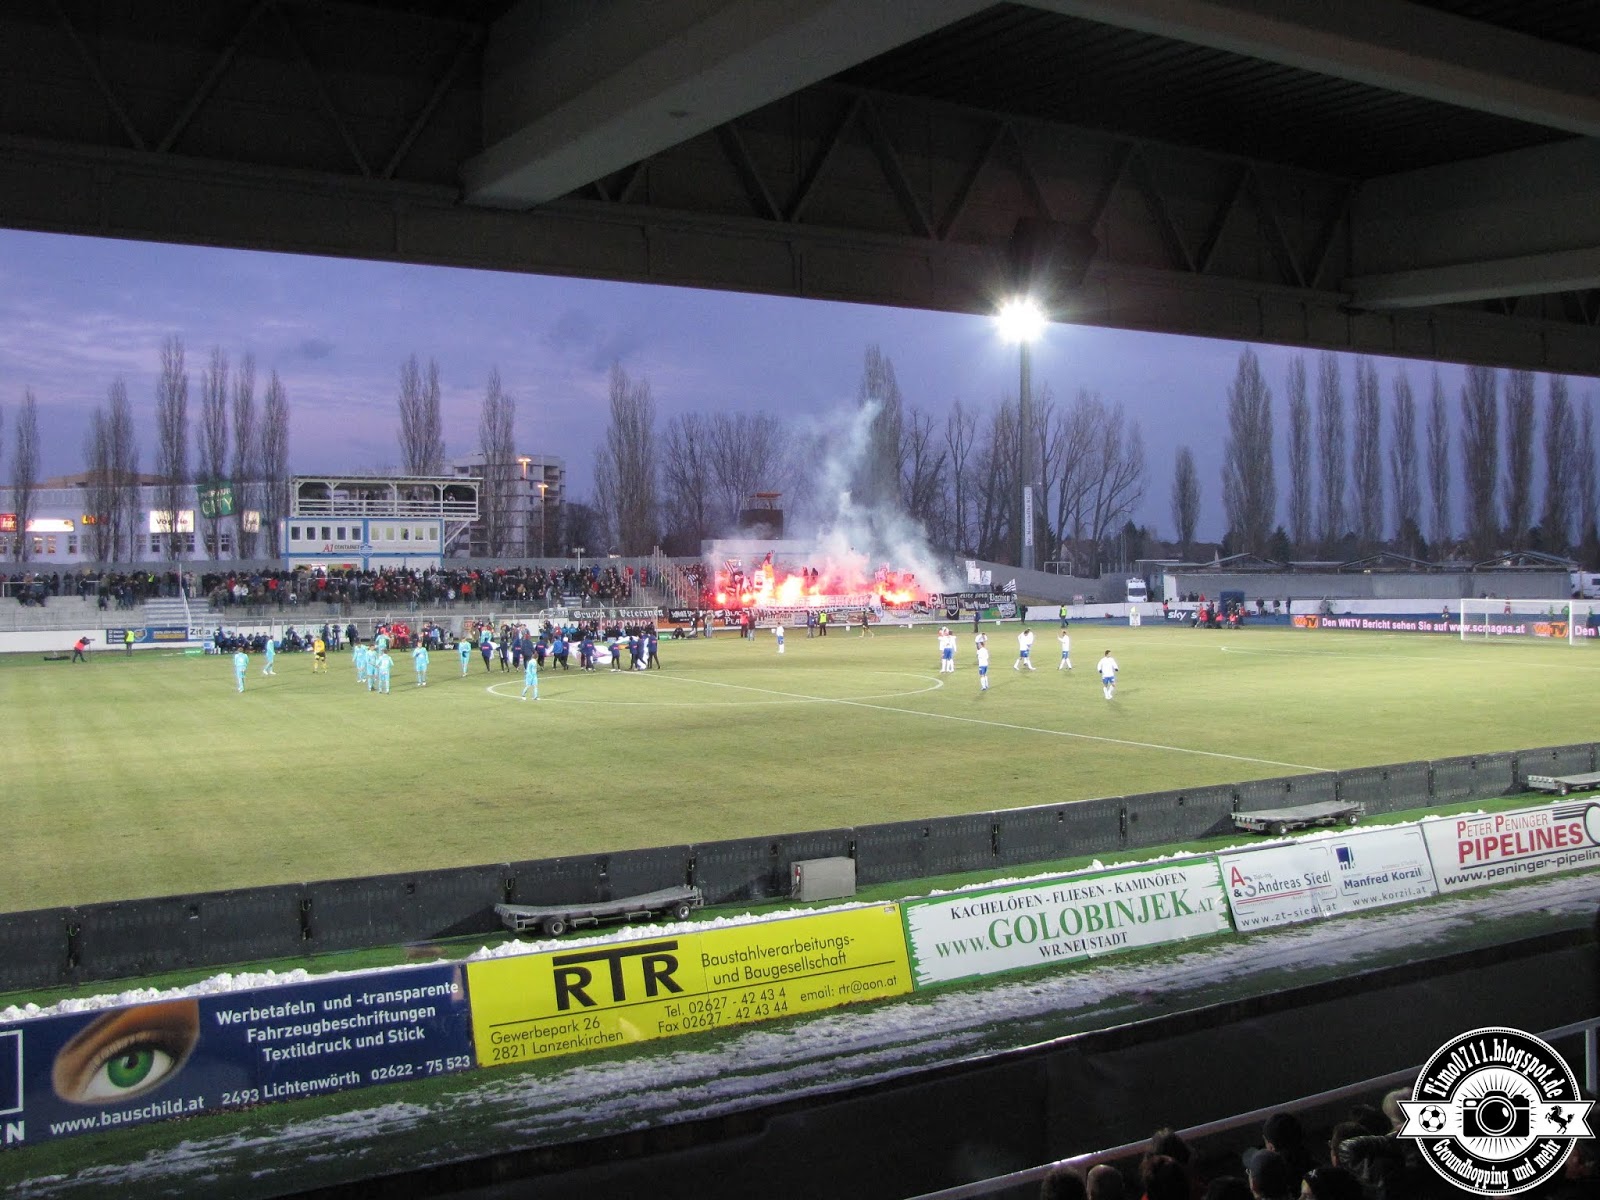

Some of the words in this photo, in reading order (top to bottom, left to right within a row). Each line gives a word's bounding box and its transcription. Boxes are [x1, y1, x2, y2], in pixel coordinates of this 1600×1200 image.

[1167, 609, 1187, 620] sky
[1322, 617, 1337, 627] Den
[1338, 618, 1361, 628] WNTV
[1363, 619, 1390, 629] Bericht
[1392, 620, 1416, 630] sehen
[1418, 621, 1432, 631] Sie
[1433, 621, 1447, 632] auf
[1449, 623, 1525, 636] www.scmagna.at
[1574, 626, 1595, 636] Den
[1456, 819, 1492, 839] PETER
[1495, 813, 1549, 833] PENINGER
[1458, 822, 1584, 864] PIPELINES
[1258, 878, 1302, 895] Andreas
[1306, 870, 1332, 887] Siedl
[1343, 874, 1388, 890] Manfred
[1391, 867, 1423, 882] Korzil
[951, 893, 1044, 920] KACHELÖFEN
[1053, 885, 1106, 904] FLIESEN
[1115, 872, 1188, 895] KAMINÖFEN
[1352, 885, 1427, 907] www.korzil.at
[1241, 902, 1337, 928] www.zt-siedl.at
[701, 934, 855, 969] Baustahlverarbeitungs-
[1039, 931, 1129, 959] WR.NEUSTADT
[553, 940, 684, 1012] RTR
[713, 969, 740, 986] und
[745, 951, 847, 981] Baugesellschaft
[664, 1003, 685, 1018] Tel.
[688, 997, 728, 1014] 02627
[741, 992, 756, 1005] 42
[760, 988, 775, 1001] 43
[779, 987, 786, 998] 4
[800, 985, 835, 1002] email:
[838, 975, 897, 995] rtr@aon.at
[216, 1001, 316, 1026] Werbetafeln
[324, 994, 352, 1011] und
[356, 982, 459, 1006] -transparente
[658, 1021, 680, 1033] Fax
[682, 1012, 722, 1030] 02627
[735, 1007, 750, 1020] 42
[755, 1003, 770, 1016] 43
[774, 1001, 788, 1013] 44
[247, 1005, 436, 1043] Fahrzeugbeschriftungen
[490, 1021, 579, 1045] Gewerbepark
[584, 1016, 601, 1031] 26
[263, 1038, 352, 1062] Textildruck
[356, 1032, 384, 1048] und
[388, 1026, 426, 1044] Stick
[492, 1046, 527, 1061] 2821
[532, 1031, 624, 1055] Lanzenkirchen
[50, 1095, 205, 1135] www.bauschild.at
[222, 1088, 260, 1106] 2493
[264, 1070, 361, 1098] Lichtenwörth
[371, 1063, 414, 1081] 02622
[426, 1058, 443, 1074] 75
[446, 1055, 471, 1071] 523
